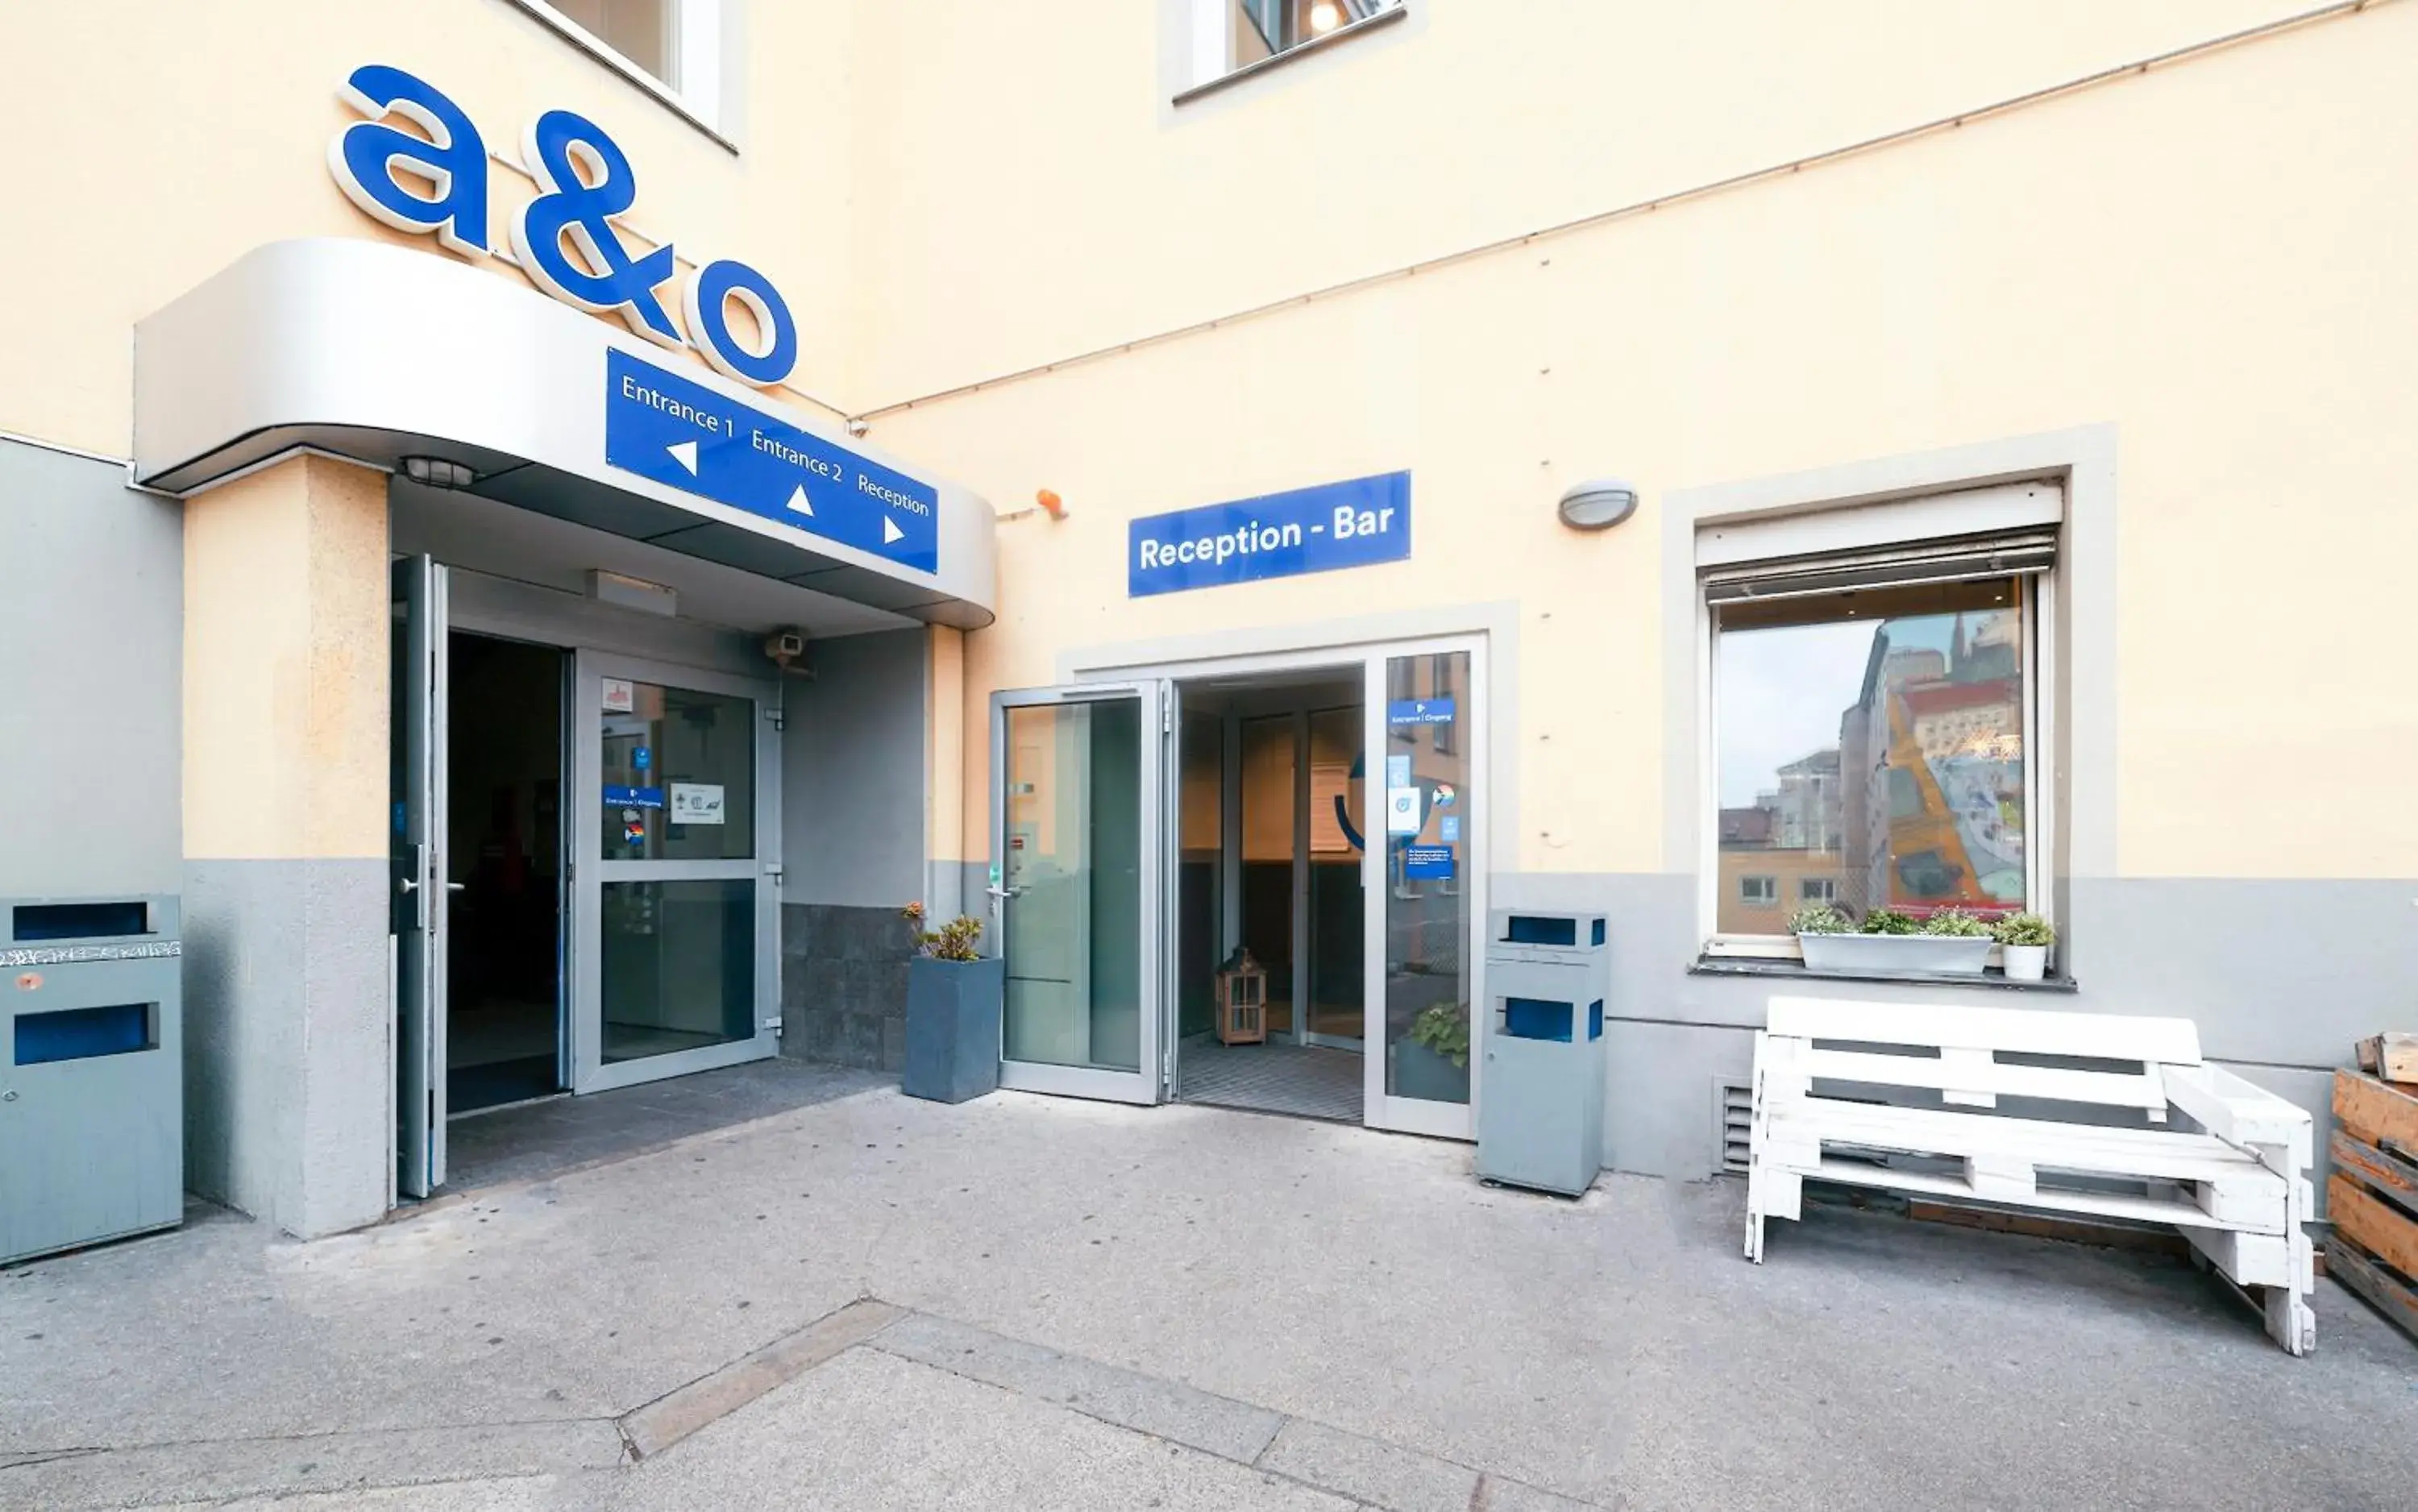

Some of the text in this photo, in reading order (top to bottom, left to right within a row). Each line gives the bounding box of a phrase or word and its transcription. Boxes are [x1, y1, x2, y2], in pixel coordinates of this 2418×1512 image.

[326, 63, 798, 388] a&o
[622, 374, 734, 438] Entrance 1
[752, 429, 843, 483] Entrance 2
[858, 473, 929, 517] Reception
[1140, 520, 1302, 569] Reception
[1333, 505, 1394, 539] Bar
